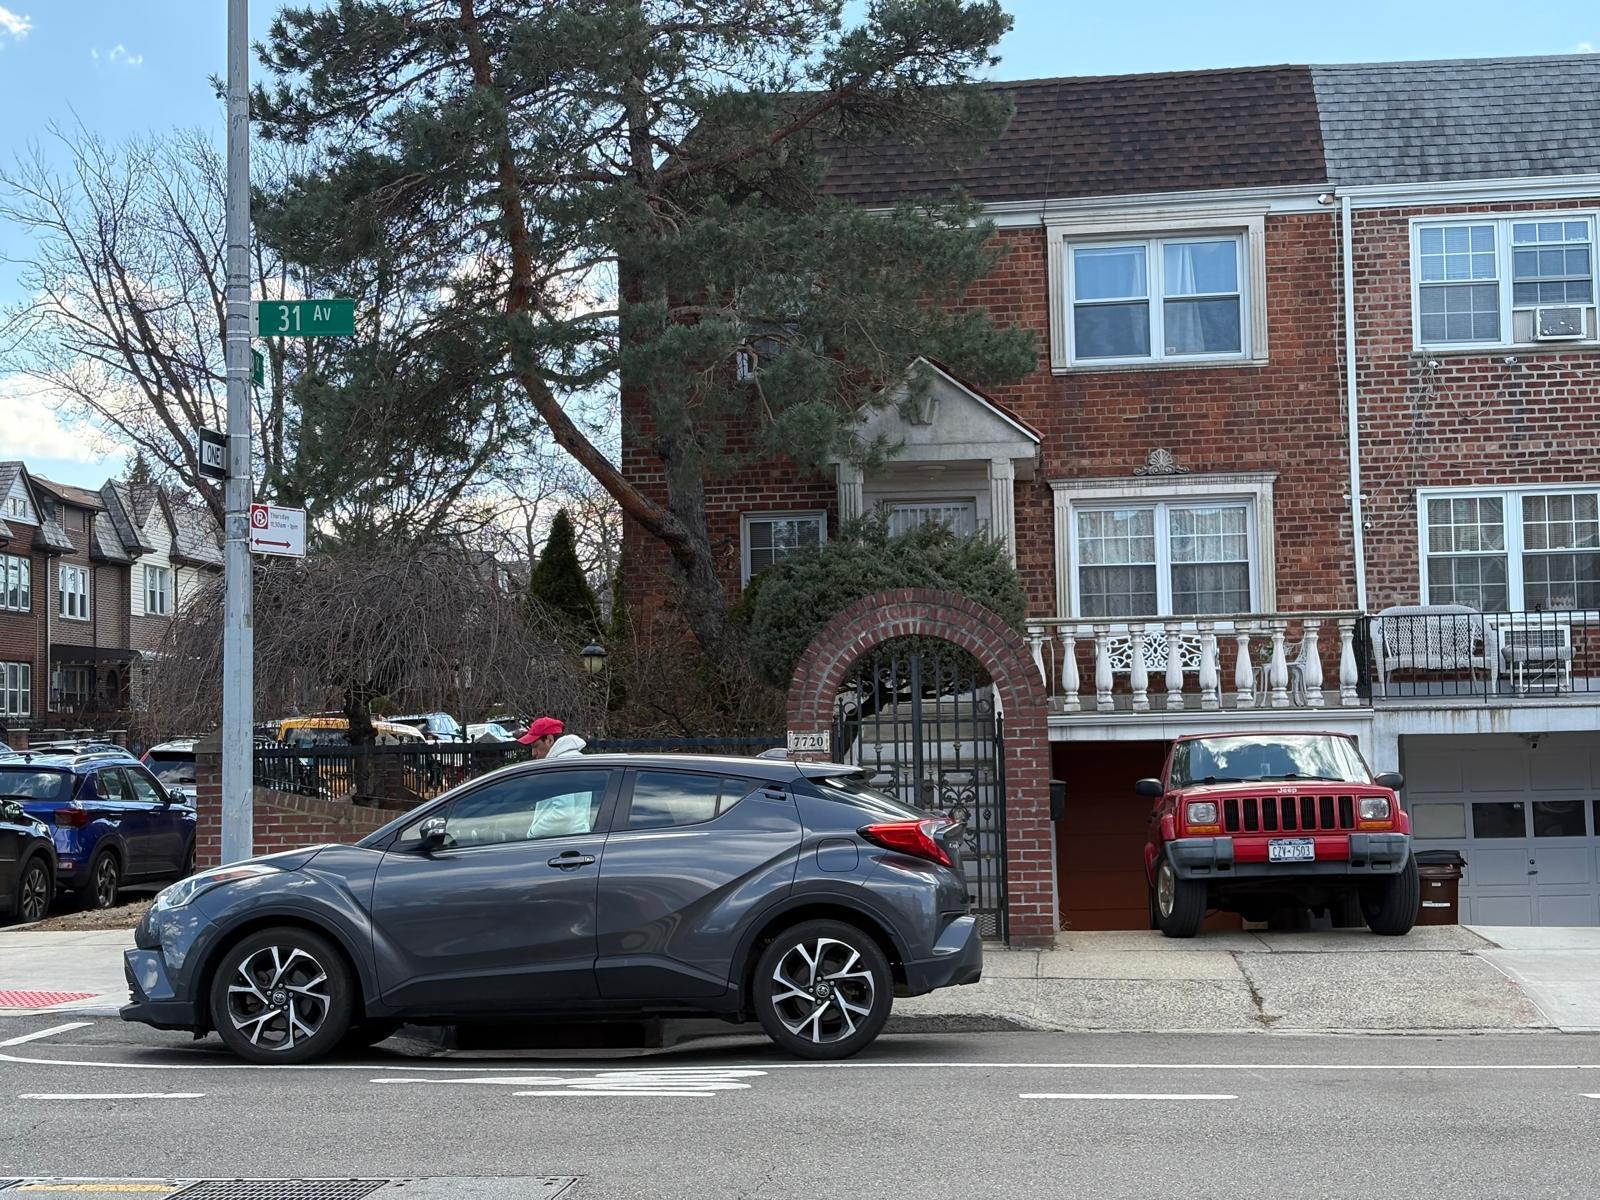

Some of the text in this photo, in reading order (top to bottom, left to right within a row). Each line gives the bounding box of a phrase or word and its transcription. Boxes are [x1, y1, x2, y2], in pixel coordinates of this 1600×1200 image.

[278, 304, 331, 332] 31 Av
[207, 444, 221, 467] ONE
[794, 736, 824, 747] 7720
